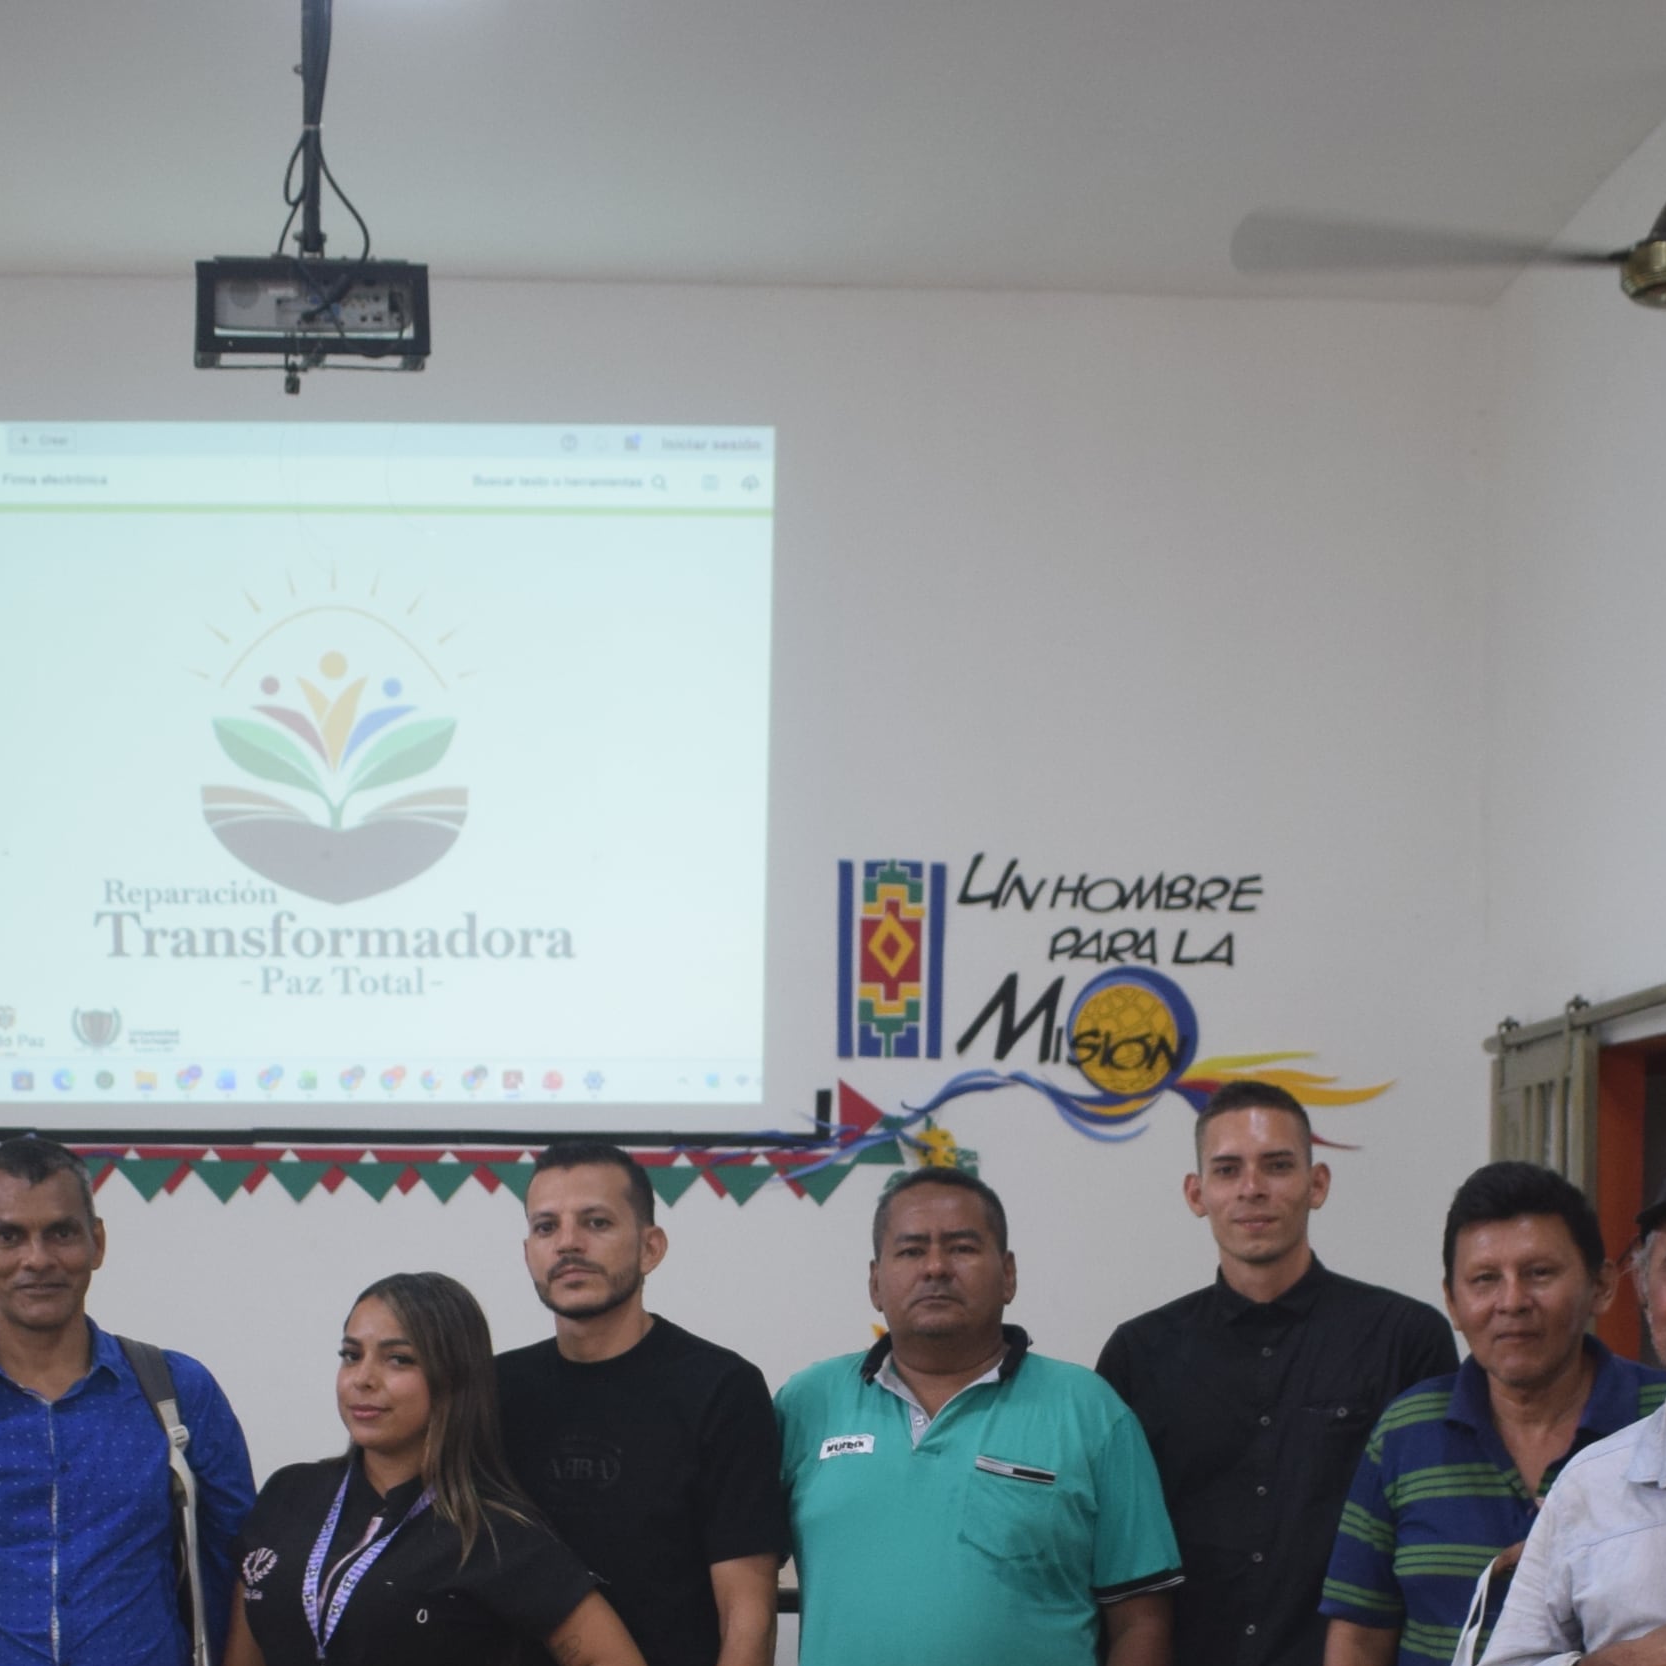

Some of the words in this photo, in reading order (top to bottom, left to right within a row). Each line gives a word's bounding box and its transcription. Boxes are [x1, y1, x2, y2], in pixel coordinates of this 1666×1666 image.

[104, 879, 278, 912] Reparación
[957, 852, 1047, 911] UN
[1049, 871, 1263, 912] HOMBRE
[94, 911, 576, 960] Transformadora
[1049, 926, 1158, 965] PARA
[1171, 929, 1233, 966] LA
